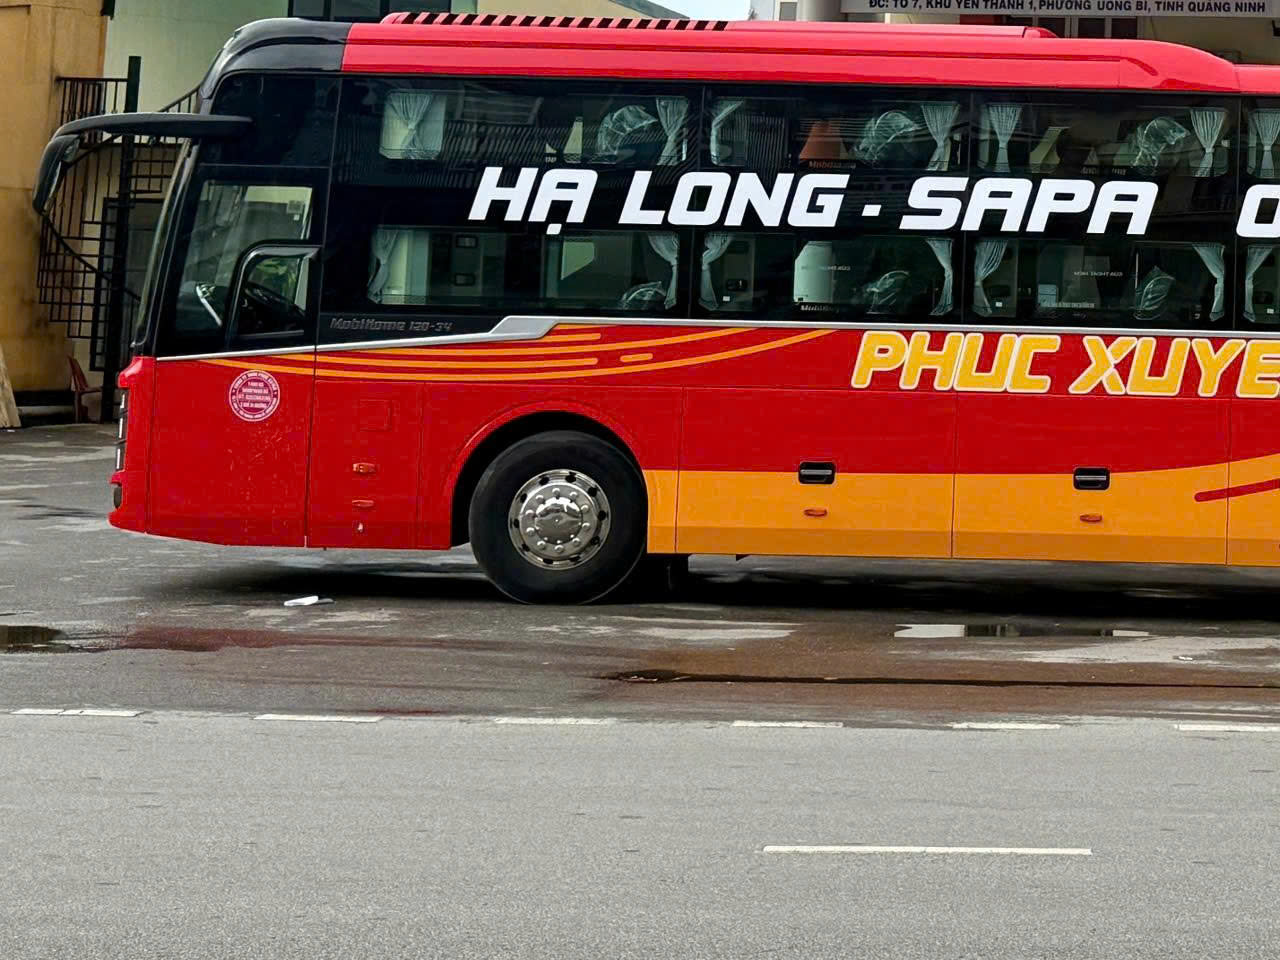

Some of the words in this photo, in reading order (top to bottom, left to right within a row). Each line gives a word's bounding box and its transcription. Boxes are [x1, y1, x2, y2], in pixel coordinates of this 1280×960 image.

[983, 0, 1024, 10] THANH
[1235, 1, 1265, 13] NINH
[468, 167, 597, 235] HẠ
[618, 170, 851, 228] LONG
[900, 176, 1159, 235] SAPA
[851, 330, 1061, 394] PHUC
